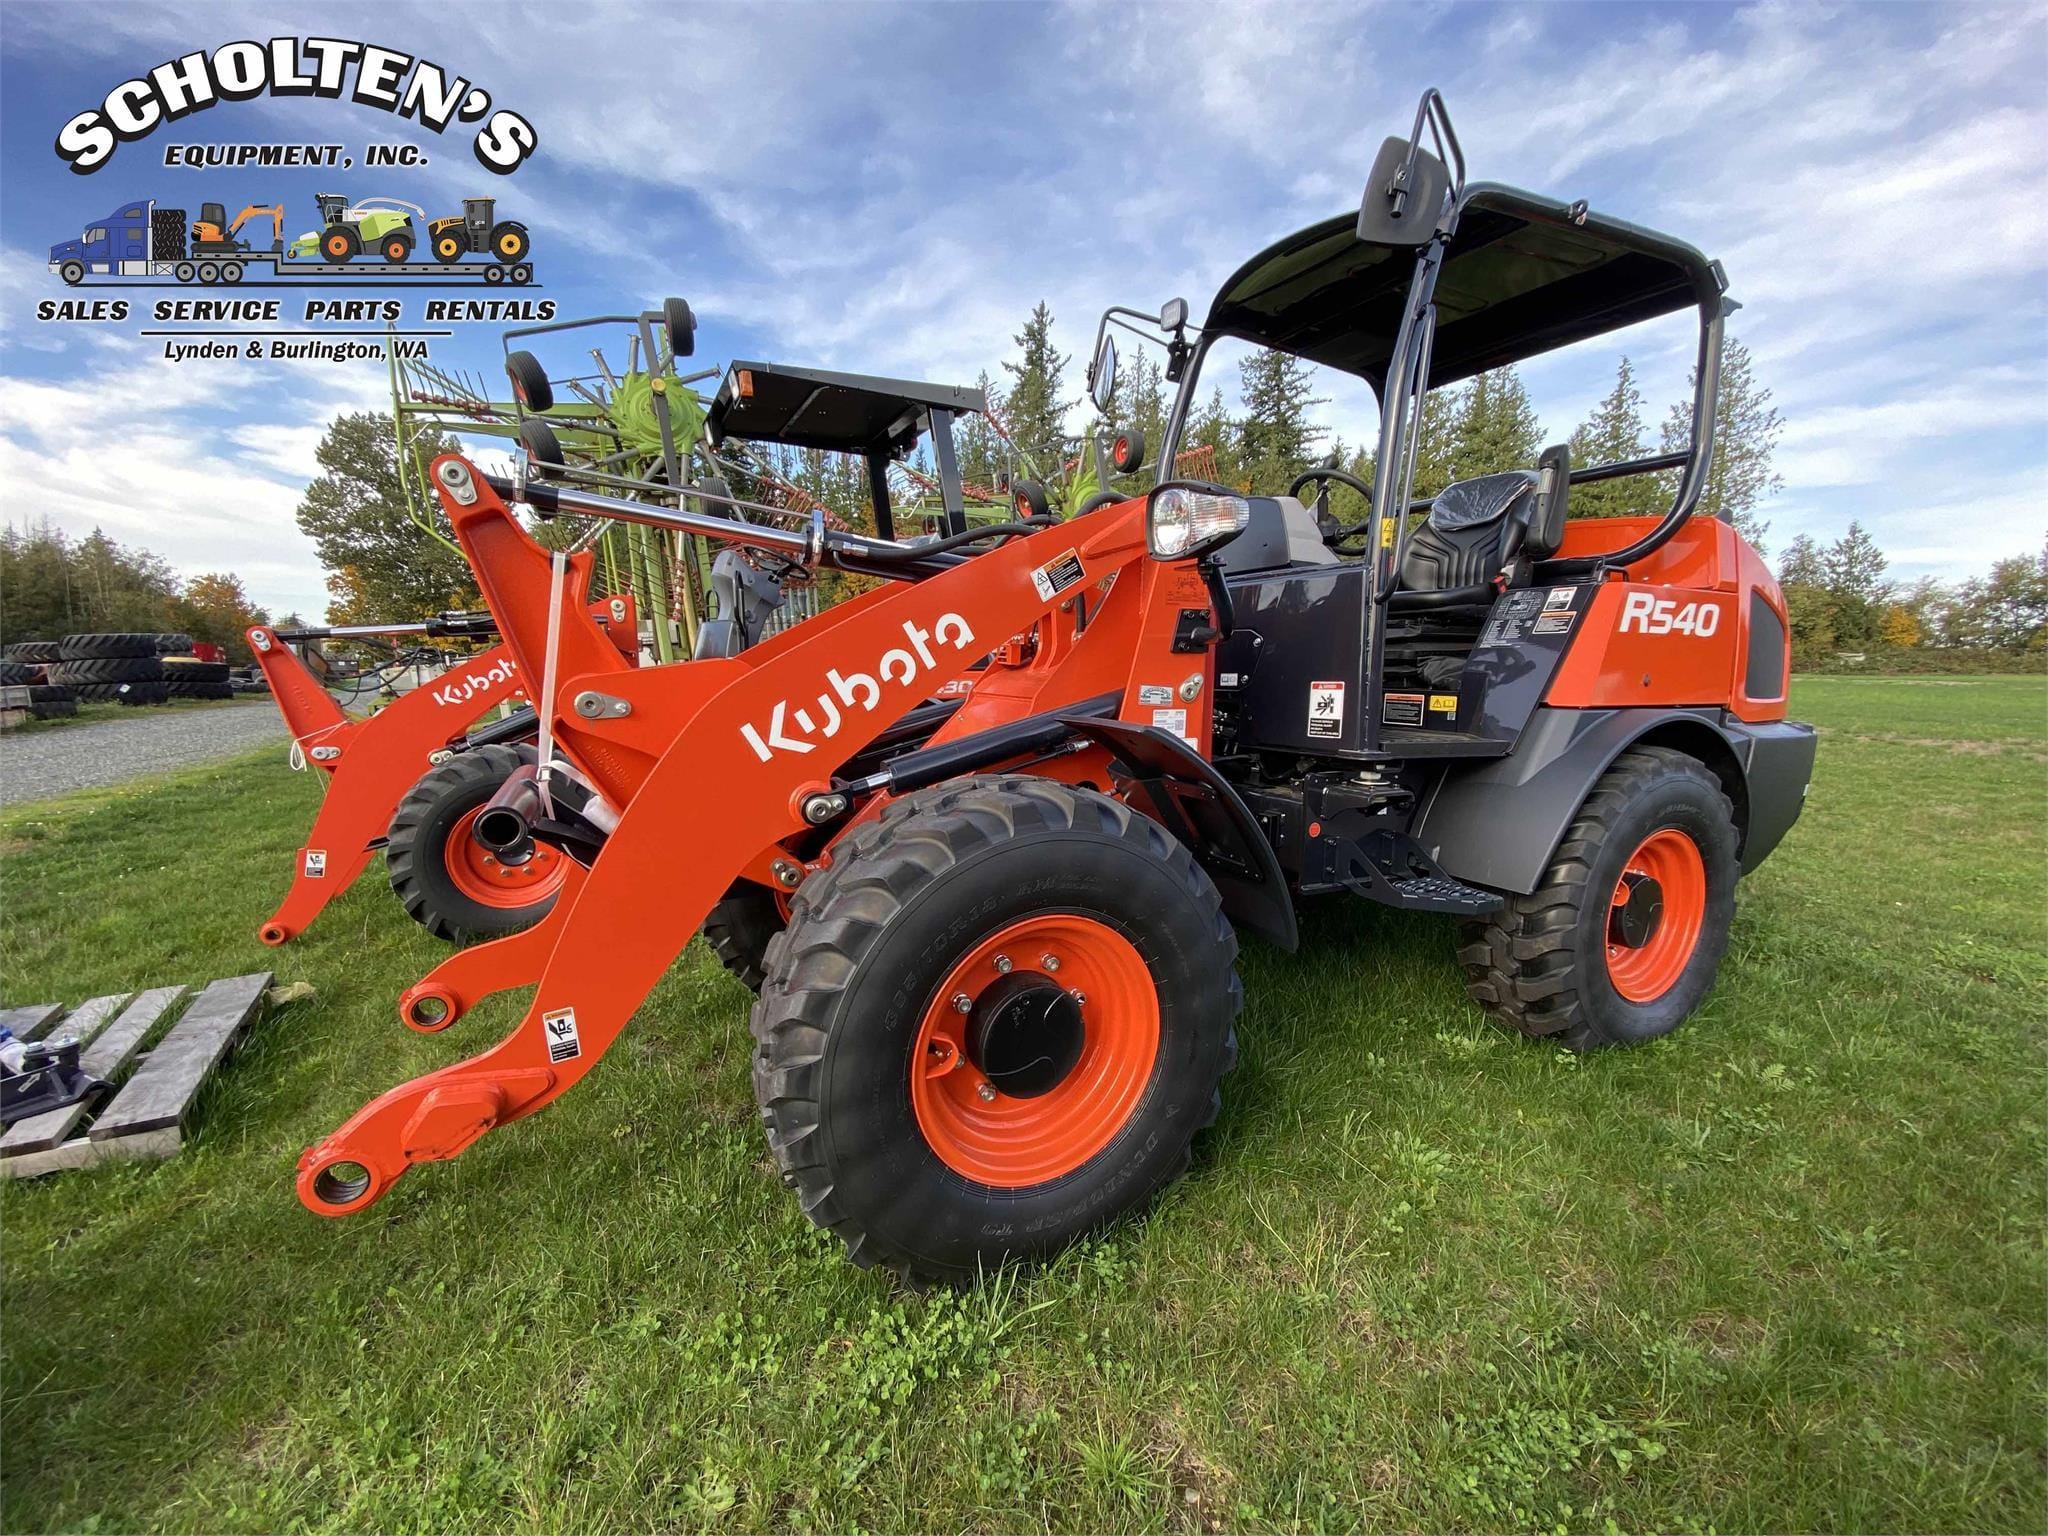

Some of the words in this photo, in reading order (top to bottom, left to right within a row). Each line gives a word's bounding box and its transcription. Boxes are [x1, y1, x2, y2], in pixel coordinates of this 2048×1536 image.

[1619, 591, 1721, 638] R540
[431, 657, 517, 707] Kubot
[740, 612, 975, 763] Kubota
